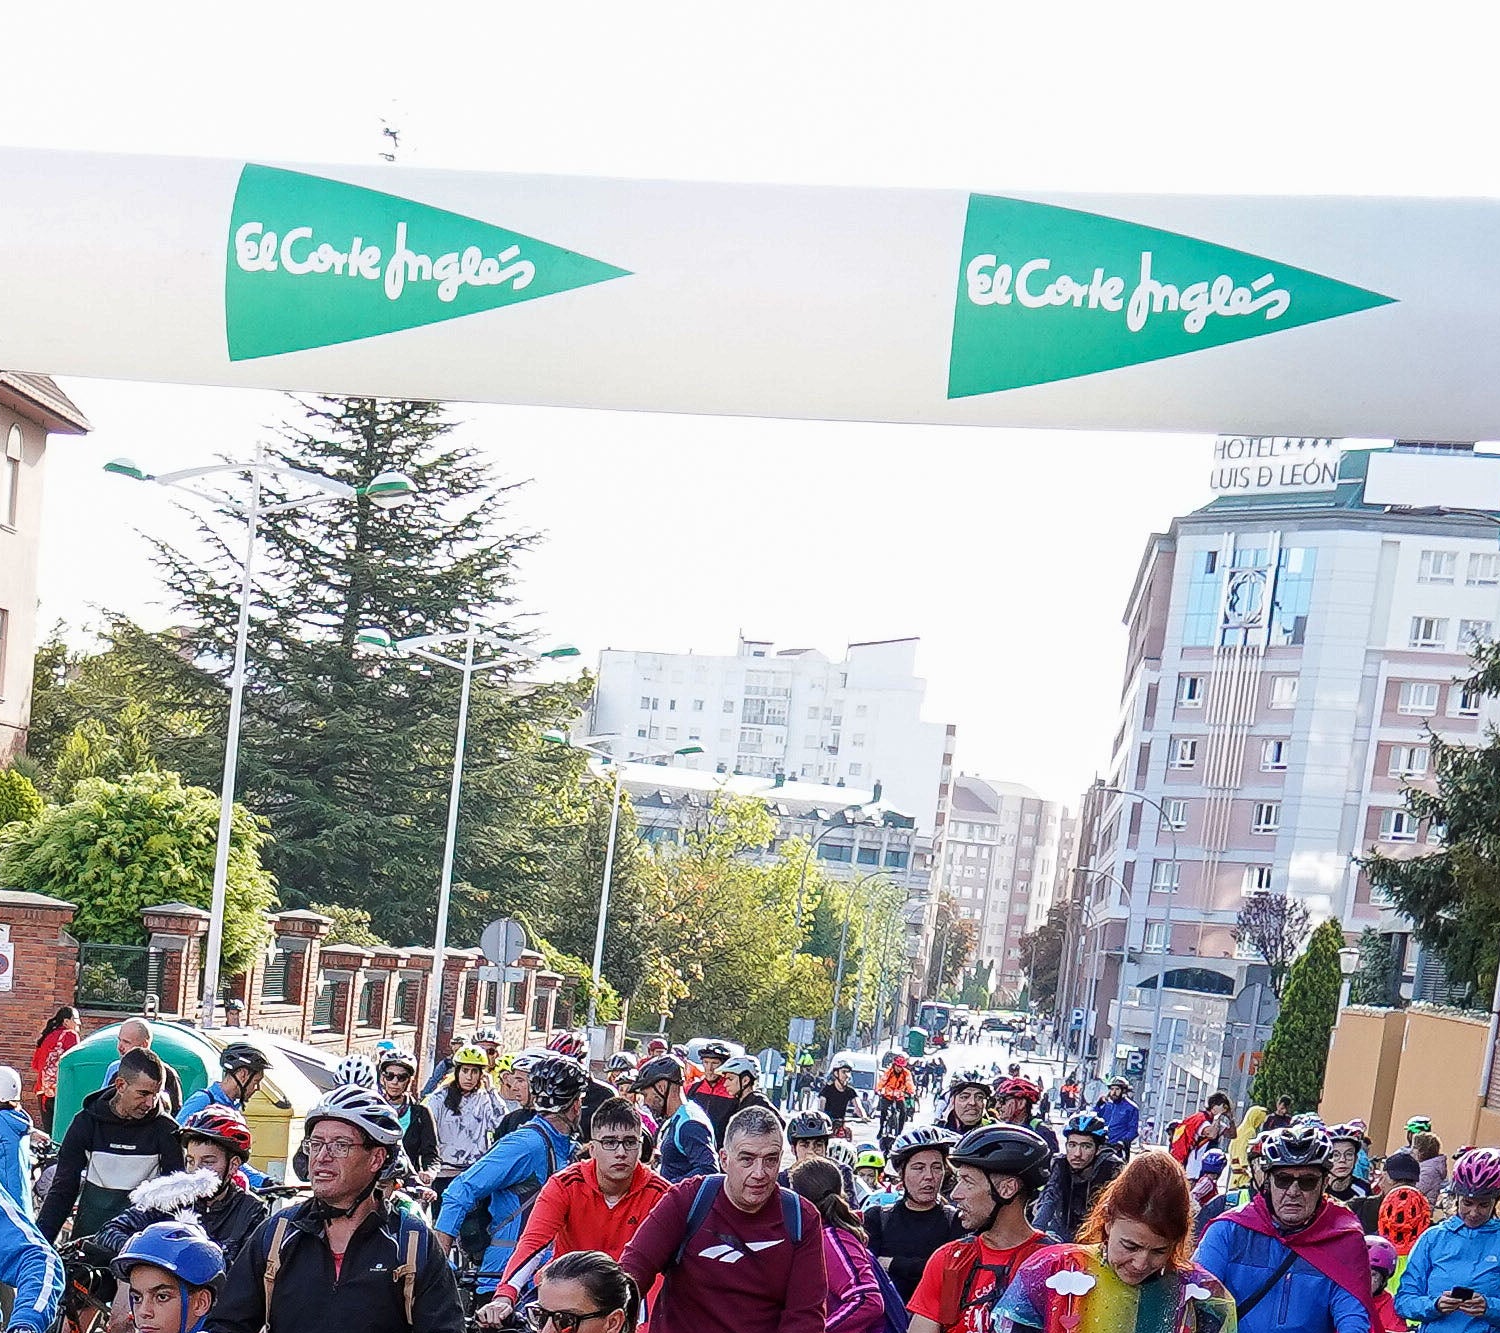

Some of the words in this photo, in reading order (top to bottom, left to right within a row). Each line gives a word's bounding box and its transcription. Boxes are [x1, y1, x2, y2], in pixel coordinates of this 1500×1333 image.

[235, 222, 277, 272] El
[280, 226, 381, 280] Corte
[384, 222, 536, 302] Inglés
[966, 254, 1012, 306] El
[1014, 258, 1124, 312] Corte
[1126, 251, 1291, 333] Inglés
[1210, 466, 1250, 489] LUIS
[1280, 458, 1338, 486] LEÓN
[1213, 437, 1280, 460] HOTEL
